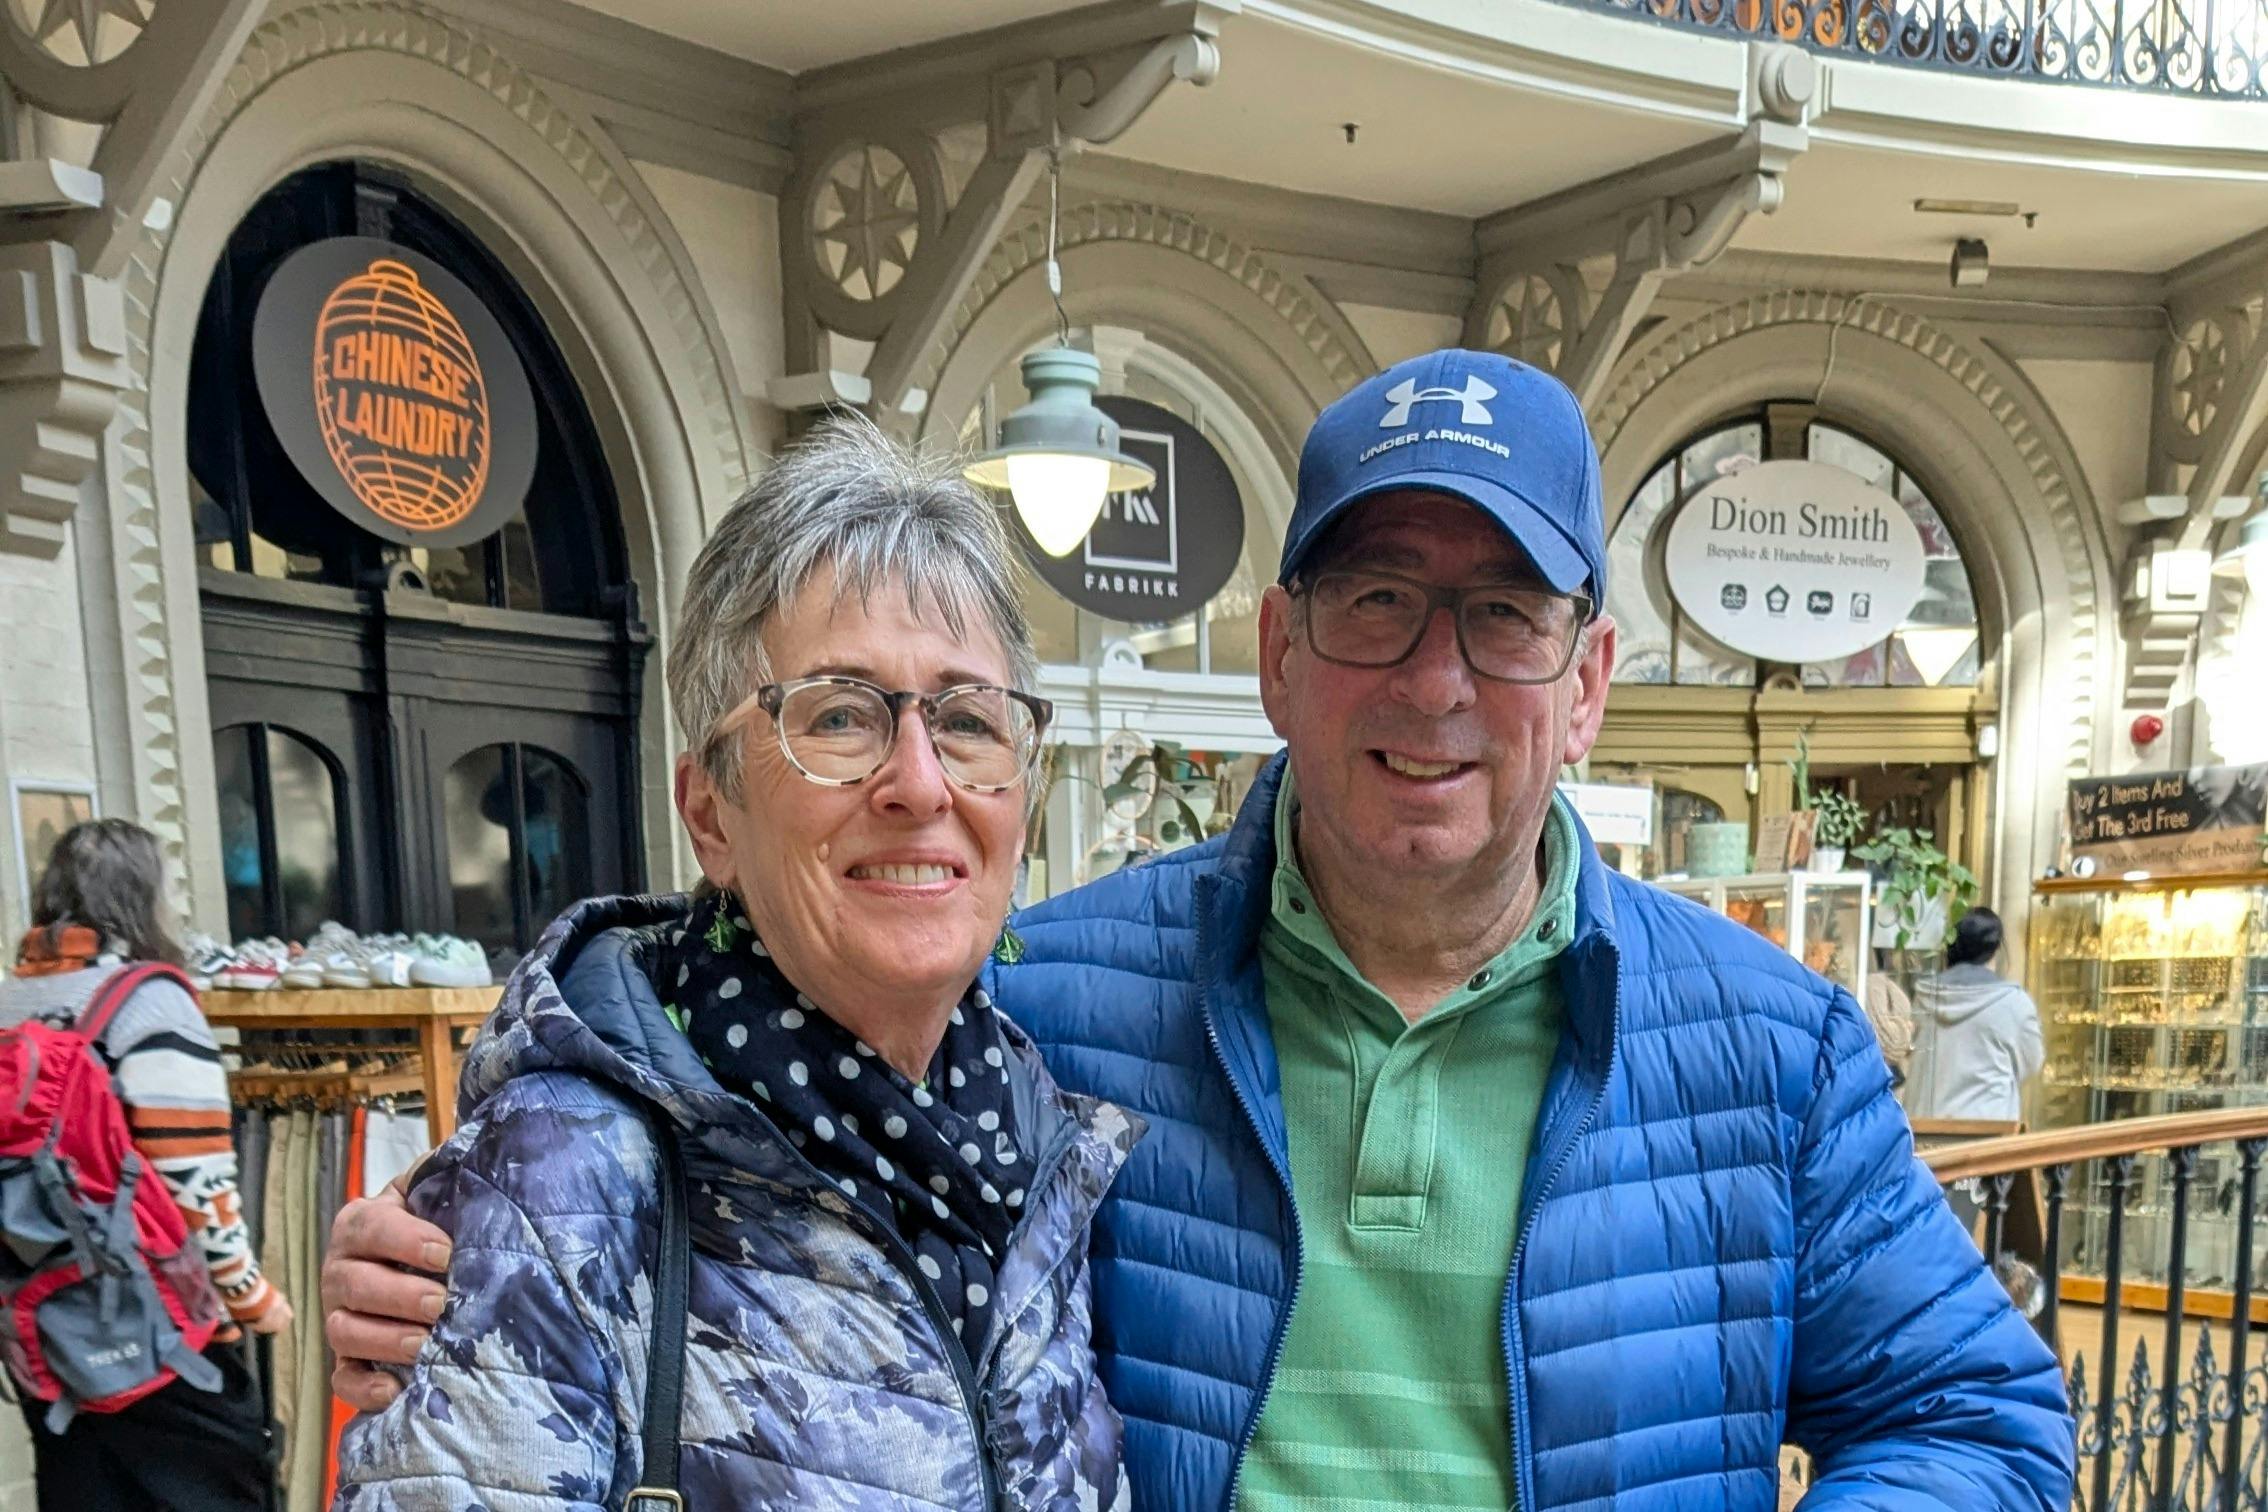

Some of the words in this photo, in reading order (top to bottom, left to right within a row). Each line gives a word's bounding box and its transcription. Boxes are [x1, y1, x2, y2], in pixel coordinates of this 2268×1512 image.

[332, 330, 471, 409] CHINESE
[337, 386, 473, 459] LAUNDRY
[1359, 433, 1419, 463] UNDER
[1424, 428, 1510, 459] ARMOUR
[1710, 496, 1787, 536] Dion
[1797, 502, 1889, 543] Smith
[1706, 542, 1757, 562] Bespoke
[1759, 546, 1769, 561] &
[1773, 547, 1835, 566] Handmade
[1084, 571, 1179, 598] FABRIKK
[2098, 784, 2108, 808] 2
[2151, 773, 2183, 800] And
[2097, 814, 2125, 838] The
[2127, 809, 2153, 835] 3rd
[2155, 806, 2190, 832] Free
